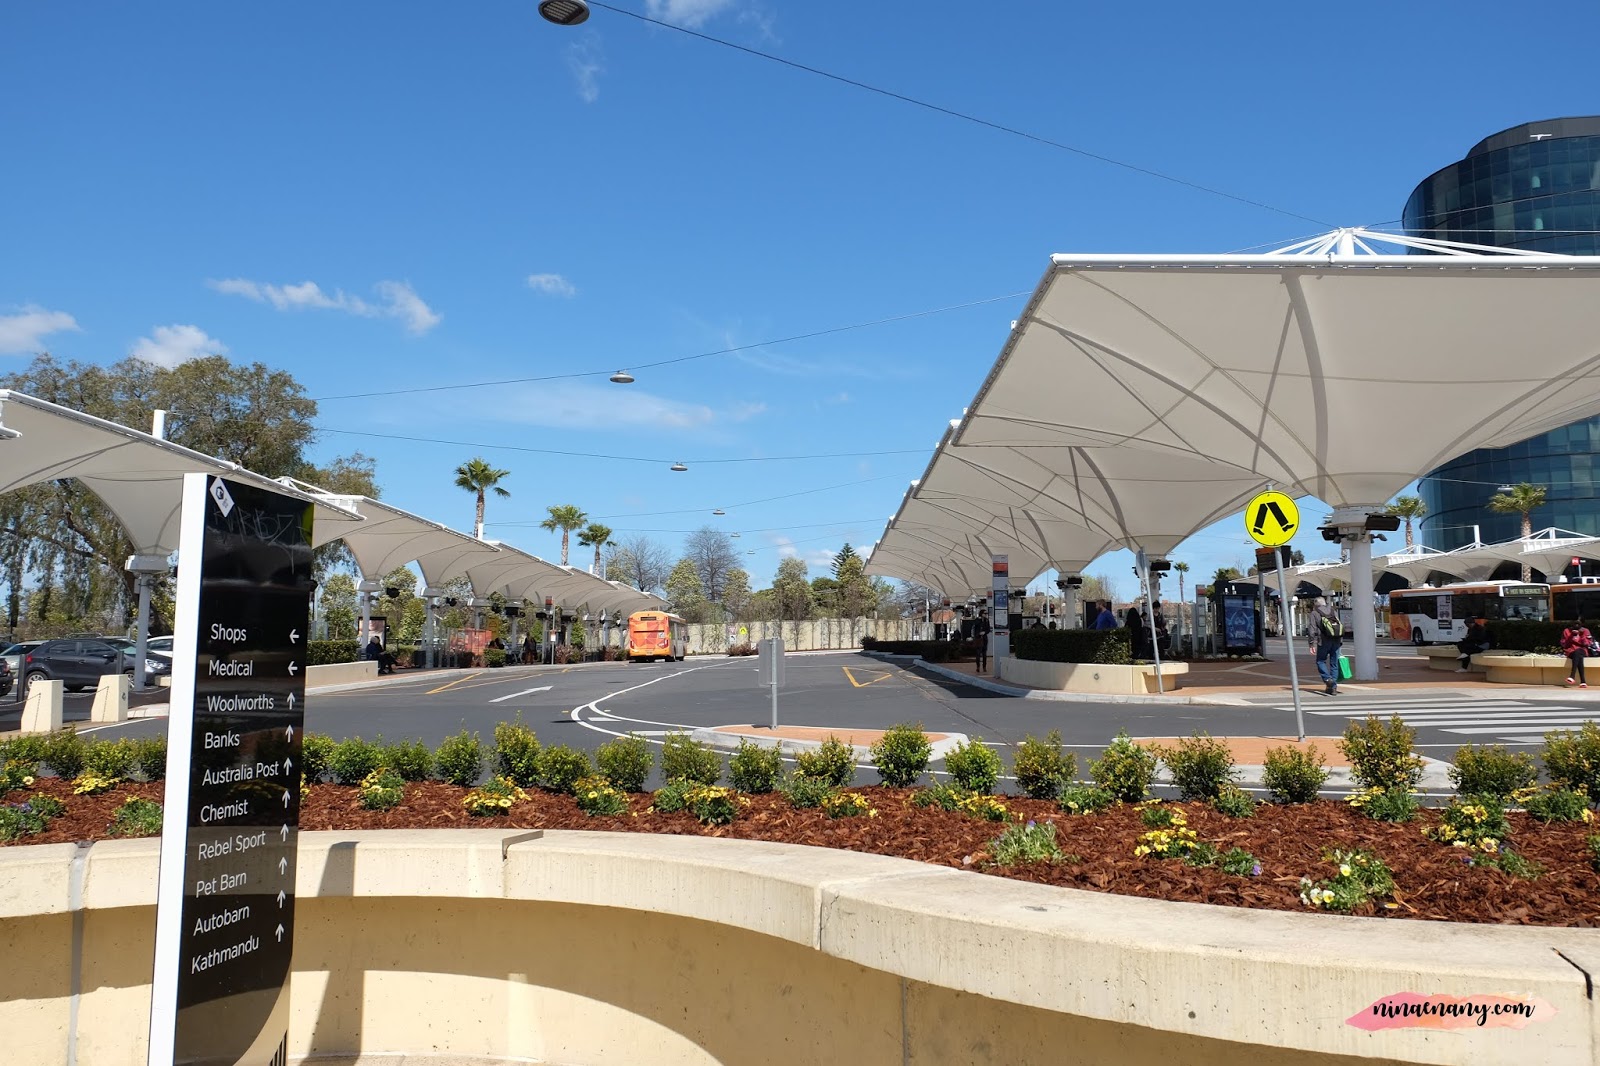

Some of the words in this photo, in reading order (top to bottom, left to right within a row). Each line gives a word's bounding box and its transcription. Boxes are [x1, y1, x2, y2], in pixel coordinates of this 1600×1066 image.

[210, 623, 247, 644] Shops
[208, 659, 253, 676] Medical
[207, 693, 274, 712] Woolworths
[204, 730, 240, 749] Banks
[201, 763, 253, 786] Australia
[255, 760, 279, 778] Post
[200, 799, 249, 823] Chemist
[198, 836, 233, 861] Rebel
[235, 830, 266, 853] Sport
[196, 877, 218, 898] Pet
[220, 872, 247, 891] Barn
[193, 905, 250, 936] Autobarn
[191, 933, 259, 975] Kathmandu
